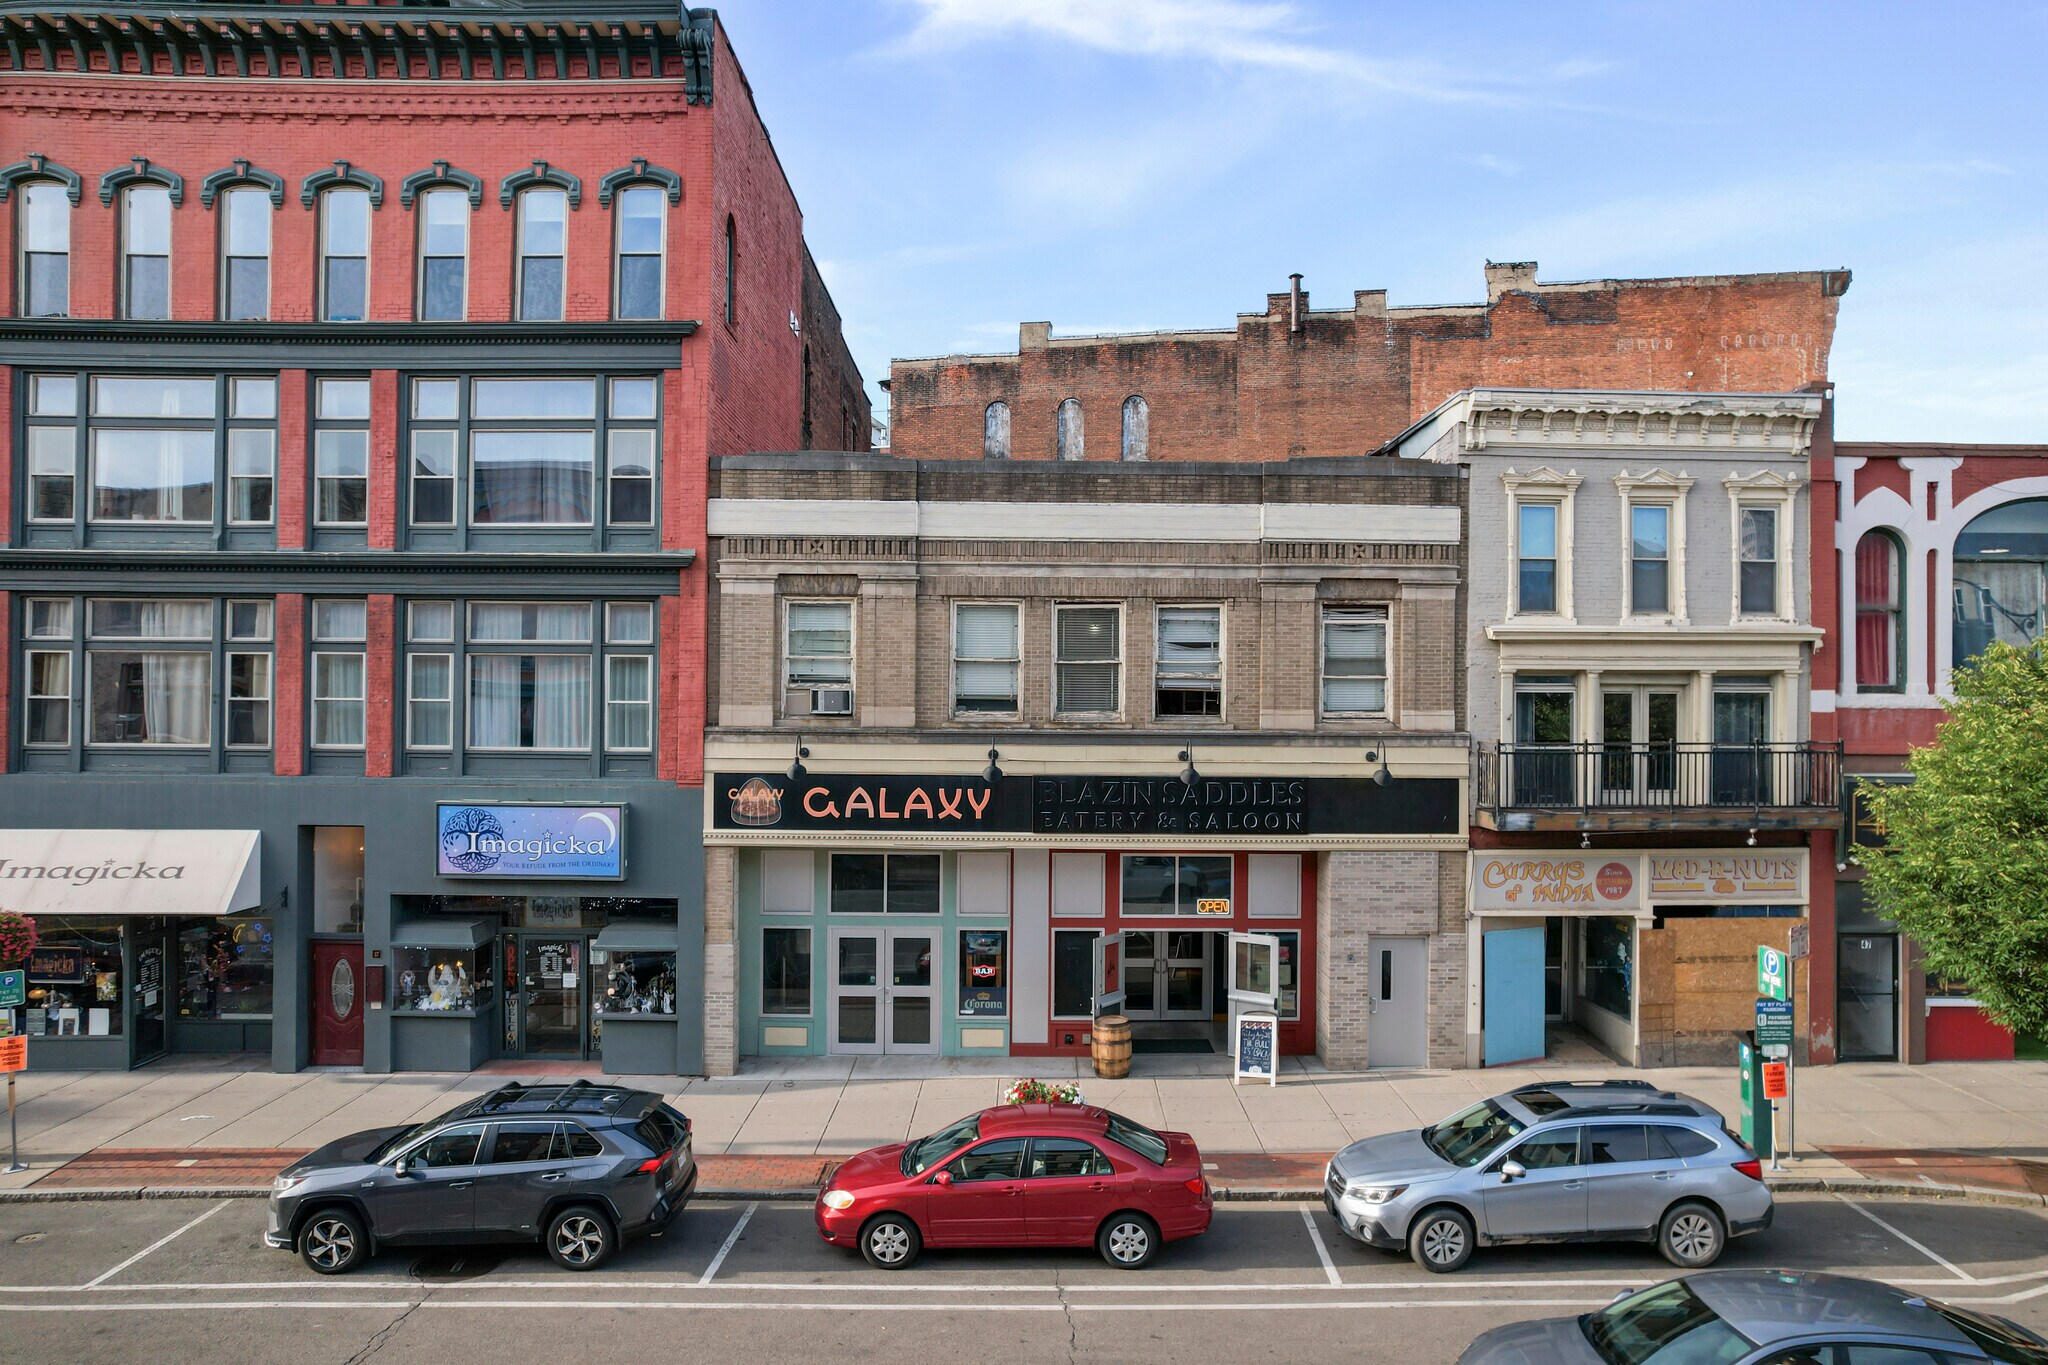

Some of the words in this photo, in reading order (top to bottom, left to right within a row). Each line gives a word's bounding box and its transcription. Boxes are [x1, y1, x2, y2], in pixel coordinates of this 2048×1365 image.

[728, 787, 784, 801] GALAXY
[803, 786, 991, 819] GALAXY
[1038, 780, 1154, 805] BLAZIN
[1162, 780, 1304, 806] SADDLES
[1040, 811, 1145, 829] EATERY
[1157, 811, 1177, 828] &
[1188, 811, 1304, 830] SALOON
[467, 829, 606, 861] Imagicka
[0, 858, 186, 886] Imagicka
[1505, 883, 1522, 902] of
[1532, 882, 1595, 903] INDIA
[1199, 901, 1228, 913] OPEN
[1861, 939, 1872, 949] 47
[964, 998, 1003, 1009] Corona
[1254, 1039, 1269, 1049] BULL
